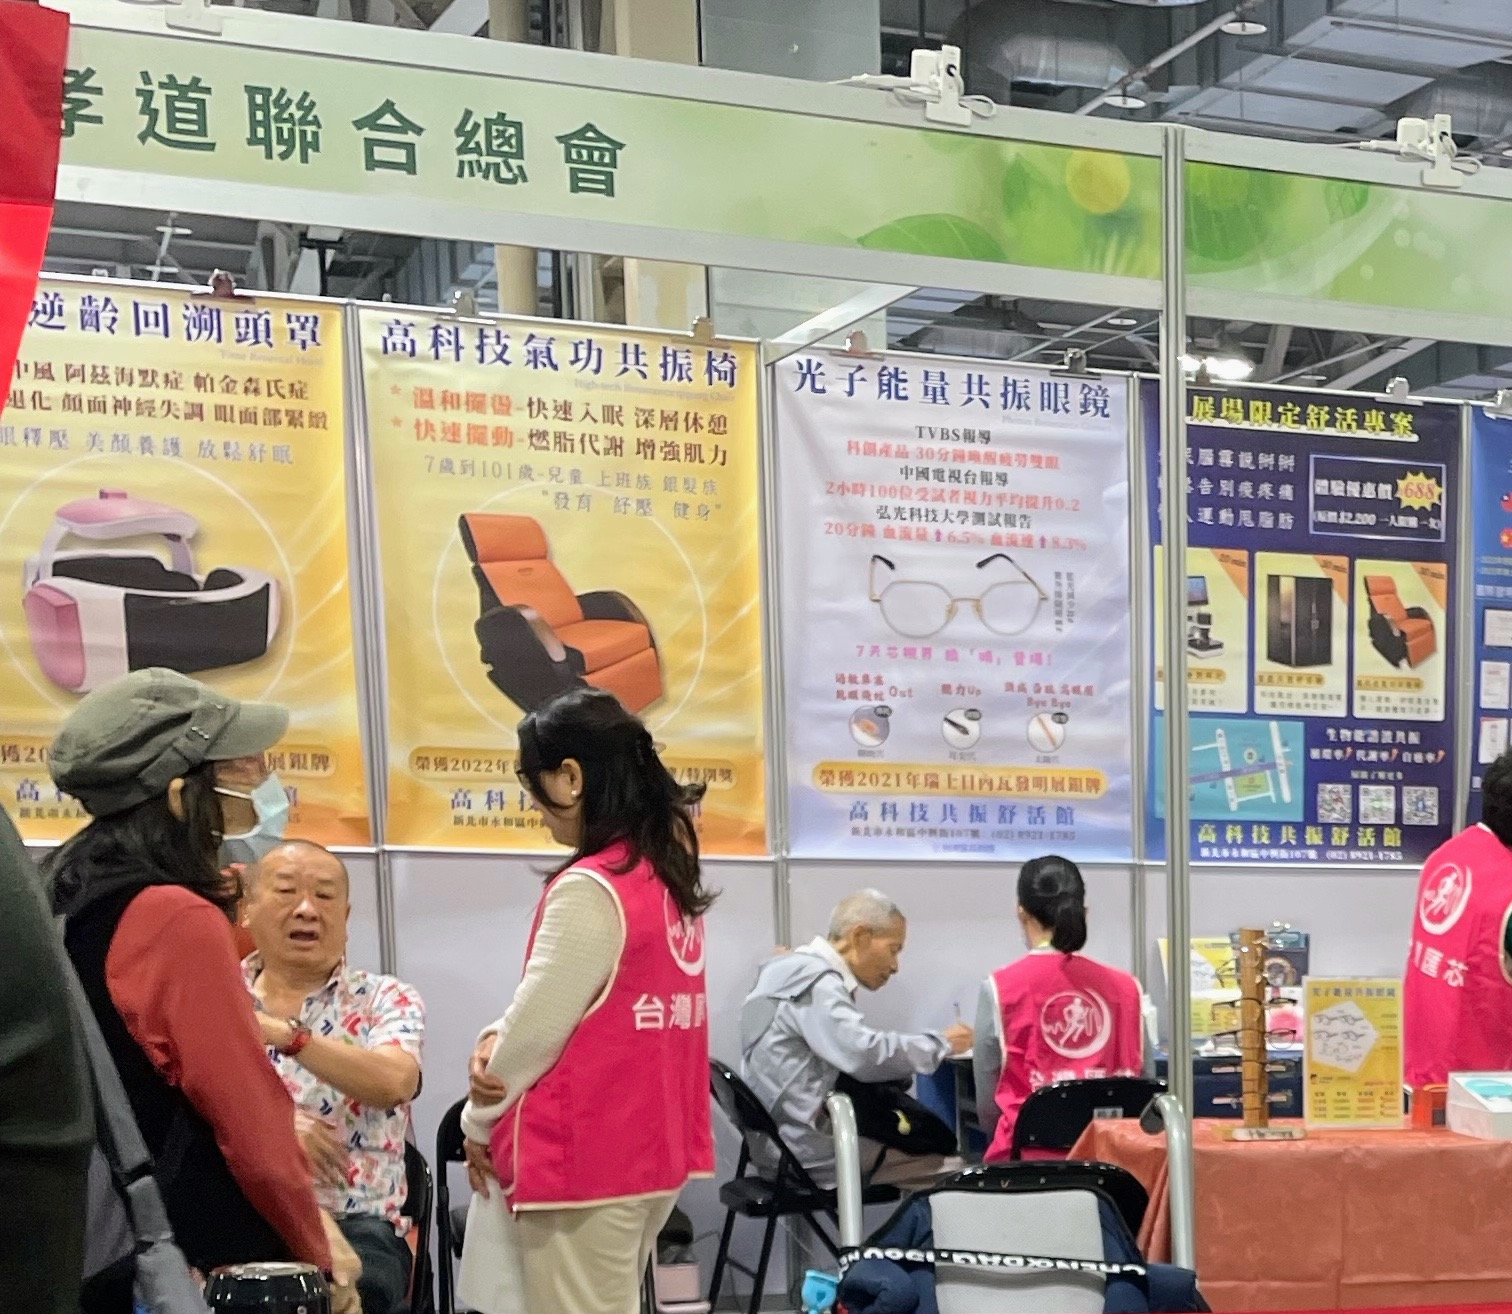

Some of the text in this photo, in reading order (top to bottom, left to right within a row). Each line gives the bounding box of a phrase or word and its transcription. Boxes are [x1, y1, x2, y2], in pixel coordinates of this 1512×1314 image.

[28, 292, 321, 351] 逆齡回溯頭罩
[380, 319, 738, 388] 高科技氣功共振椅
[65, 363, 184, 391] 阿茲海默症
[194, 371, 309, 400] 帕金森氏症
[794, 358, 1111, 419] 光子能量共振眼鏡
[634, 406, 728, 436] 深層休憩
[1193, 395, 1414, 437] 展場限定舒活專案
[635, 437, 728, 467] 增強肌力
[599, 470, 652, 491] 上班族
[1404, 482, 1436, 500] 688
[850, 801, 1075, 826] 高科技共振舒活館
